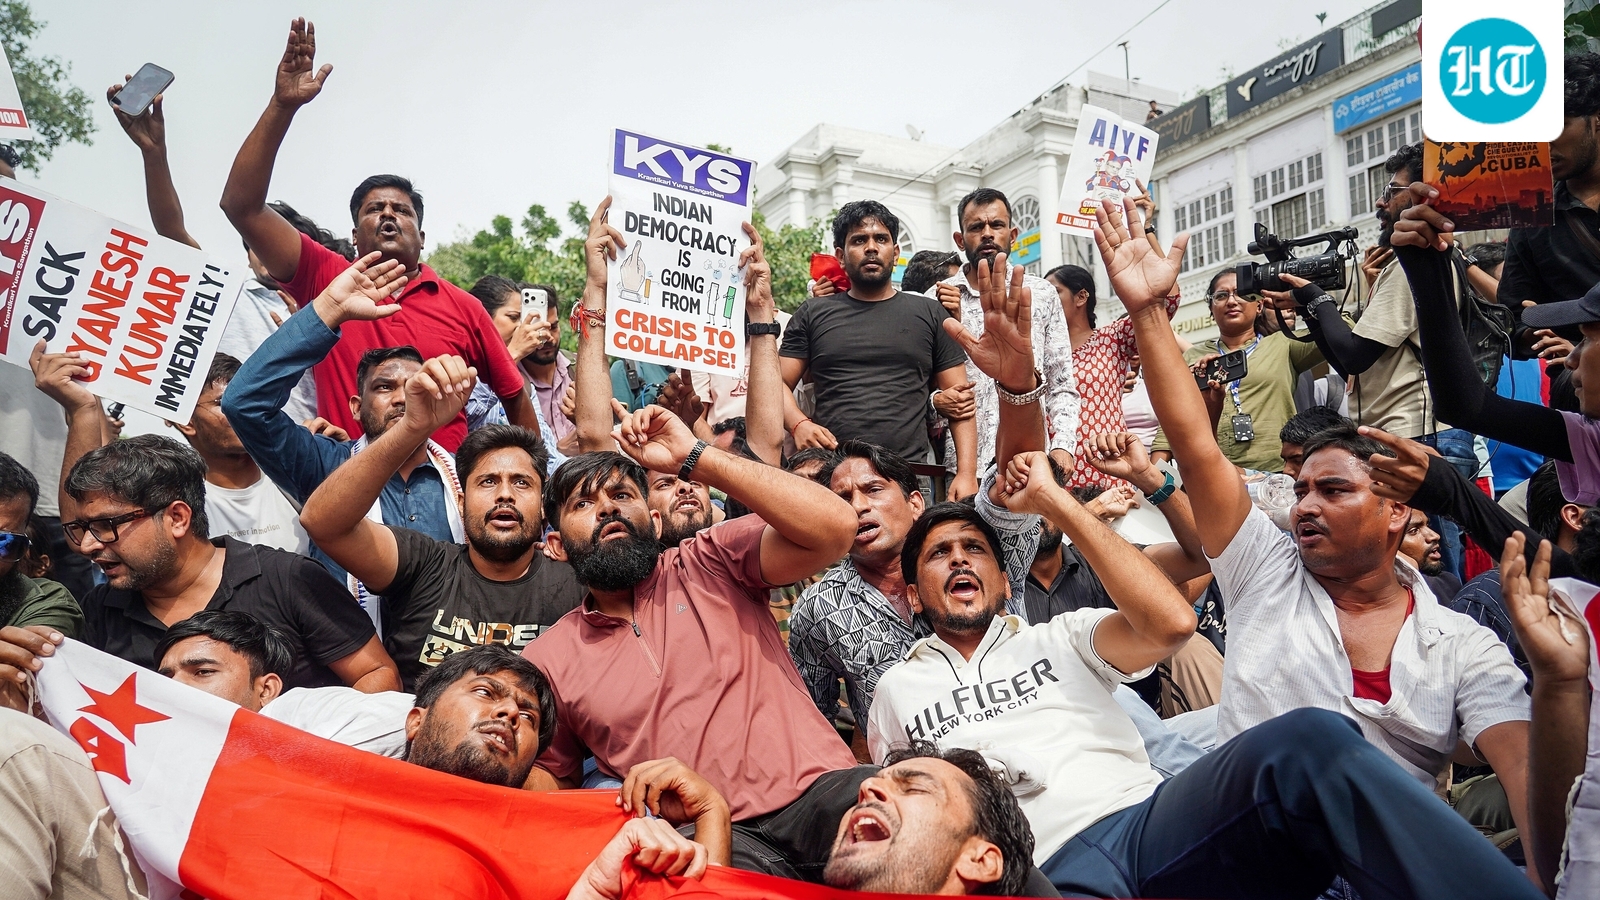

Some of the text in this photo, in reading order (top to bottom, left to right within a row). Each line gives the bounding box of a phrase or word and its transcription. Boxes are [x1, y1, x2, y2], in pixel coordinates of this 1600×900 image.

[1088, 118, 1150, 162] AIYF
[1501, 145, 1538, 153] GUEVARA
[623, 135, 743, 194] KYS
[1487, 155, 1541, 172] CUBA
[637, 172, 725, 199] Krantikari Yuva Sangathan
[653, 192, 712, 225] INDIAN
[624, 211, 737, 257] DEMOCRACY
[3, 228, 34, 328] Krantikari Yuva Sangathan
[678, 249, 691, 268] IS
[22, 241, 86, 342] SACK
[660, 268, 705, 294] GOING
[661, 292, 701, 315] FROM
[113, 266, 191, 385] KUMAR
[154, 263, 230, 412] IMMEDIATELY!
[614, 308, 735, 349] CRISIS TO
[613, 332, 736, 369] COLLAPSE!
[227, 529, 249, 538] forever
[258, 523, 280, 534] motion
[905, 658, 1060, 742] HILFIGER
[931, 691, 1040, 742] NEW YORK CITY
